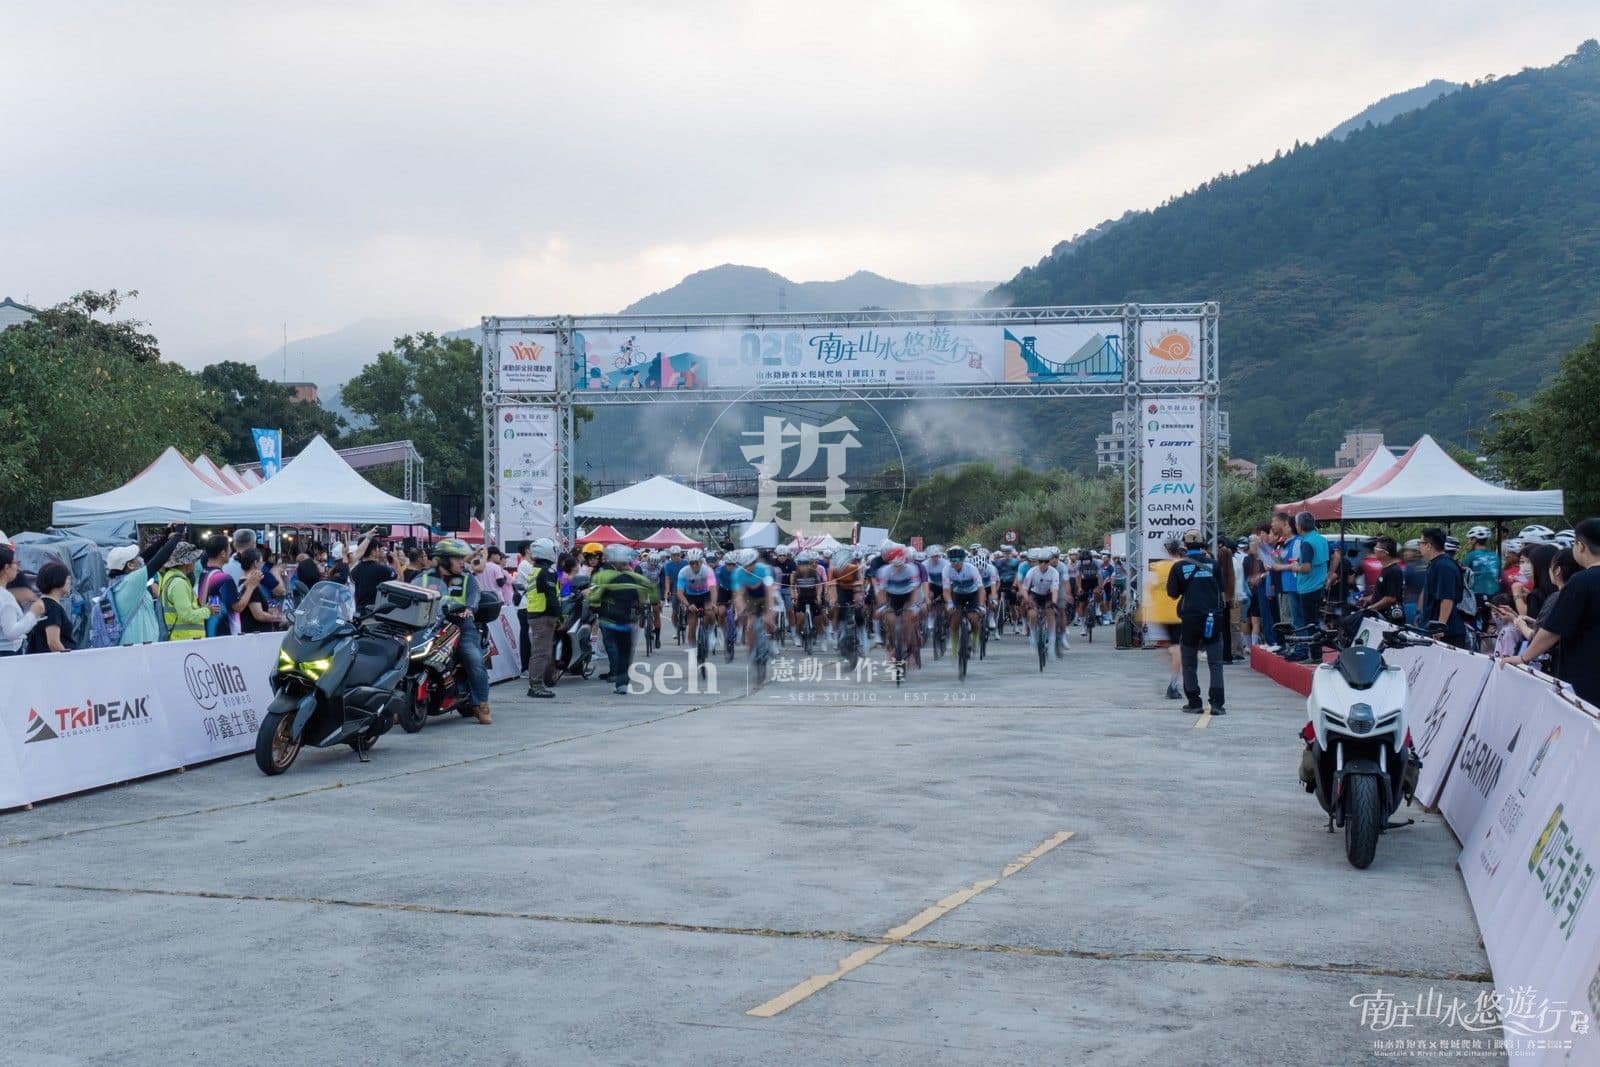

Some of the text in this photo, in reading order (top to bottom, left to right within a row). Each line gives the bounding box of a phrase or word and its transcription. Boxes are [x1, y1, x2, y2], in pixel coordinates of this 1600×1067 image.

[718, 332, 803, 367] 026
[809, 327, 971, 366] 南庄山水悠遊行
[1148, 503, 1194, 512] GARMIN
[1148, 514, 1196, 526] wahoo
[1148, 531, 1164, 539] DT
[60, 717, 153, 738] CERAMIC SPECIALIST
[1460, 732, 1504, 800] GARMIN
